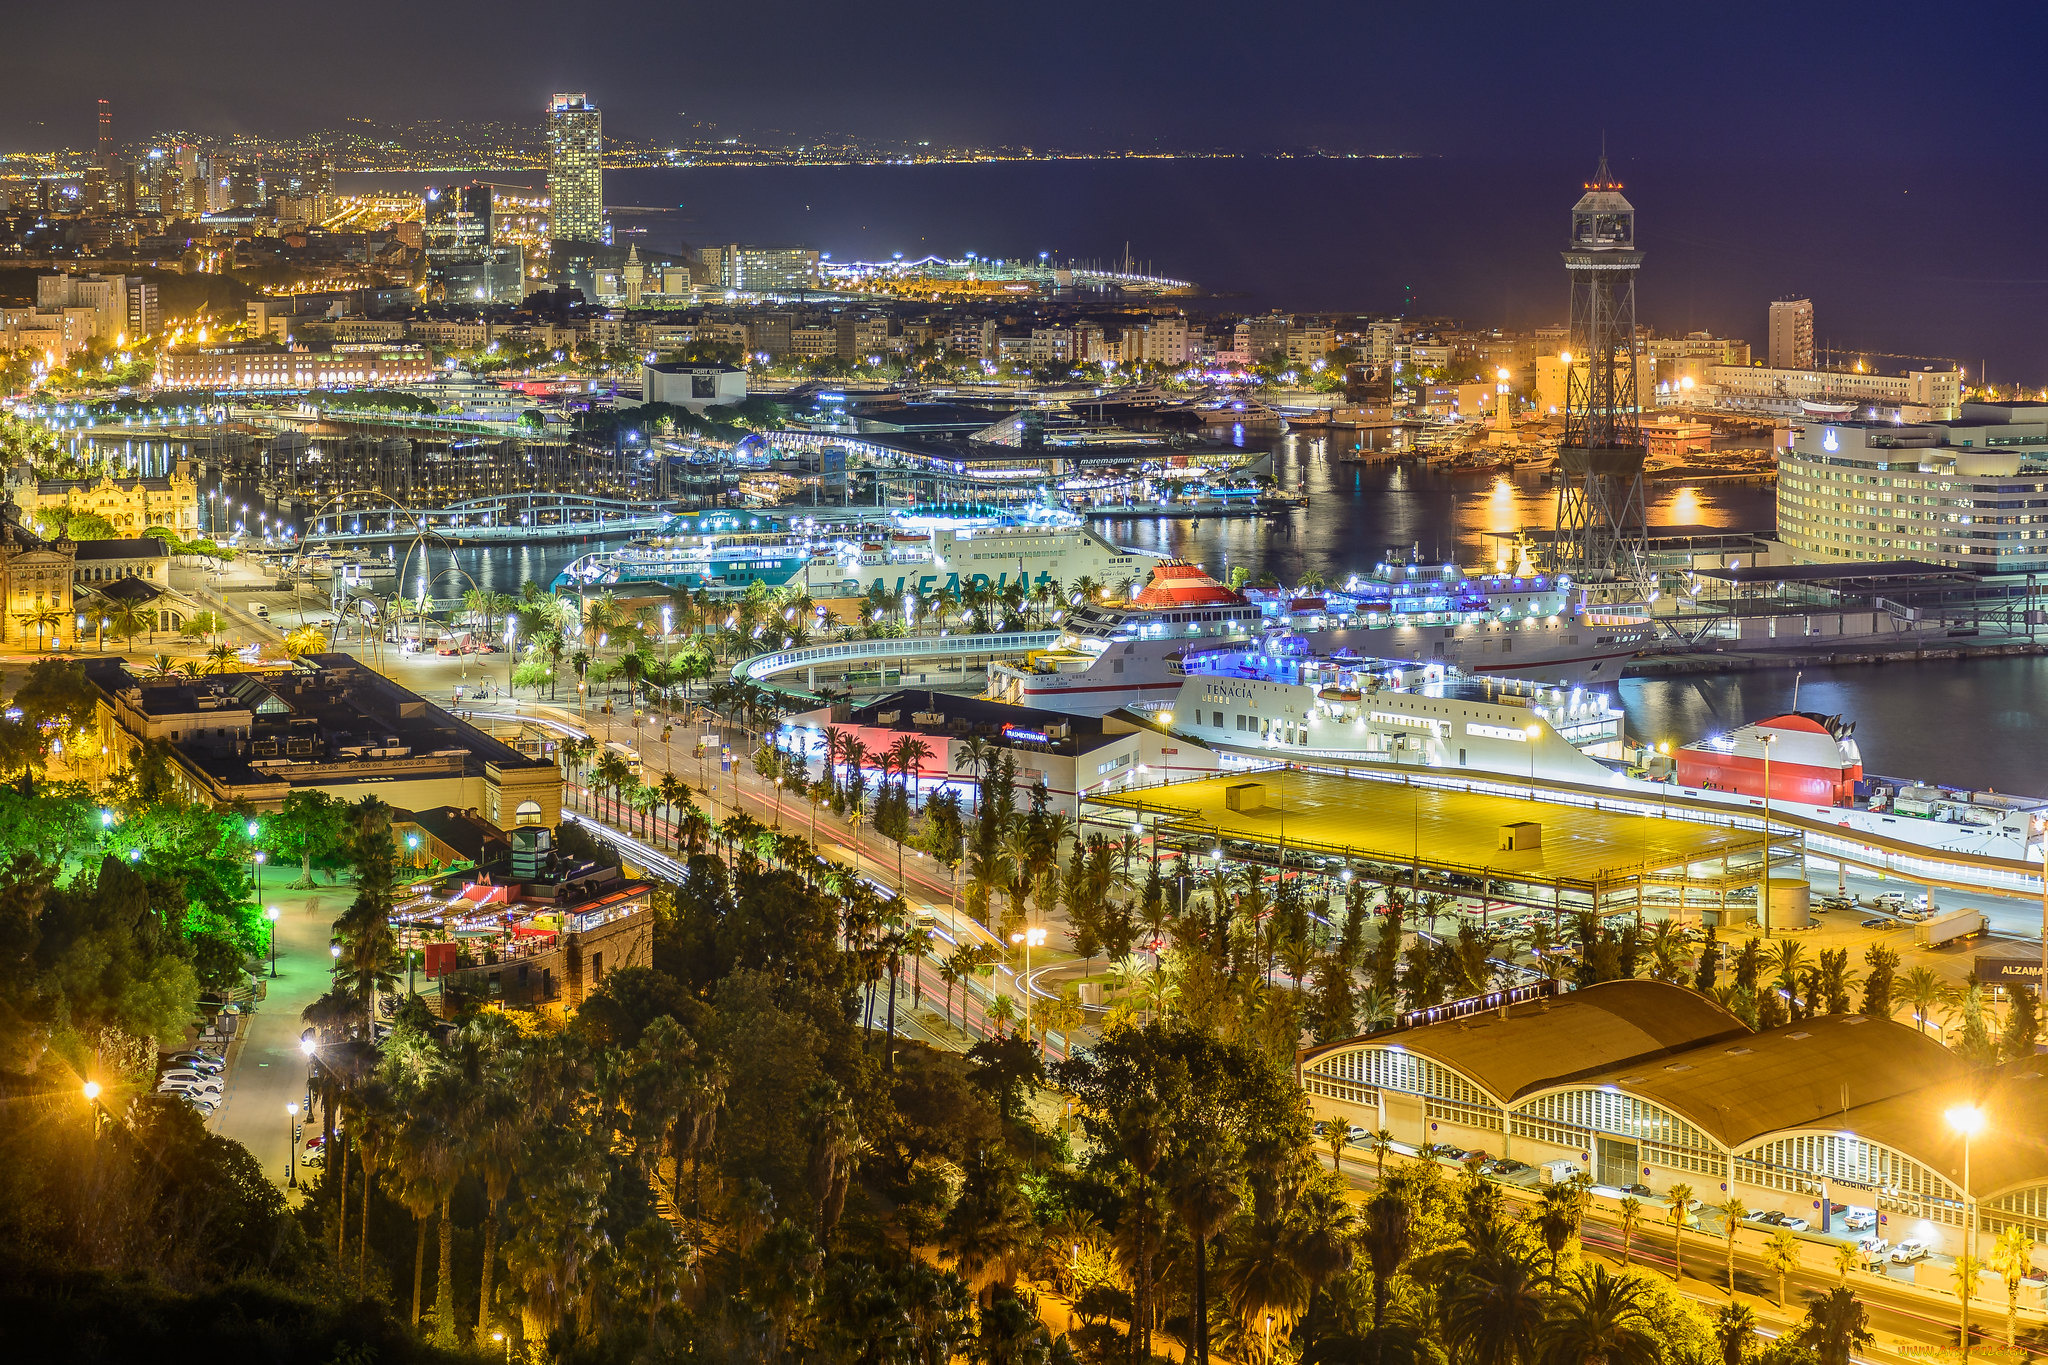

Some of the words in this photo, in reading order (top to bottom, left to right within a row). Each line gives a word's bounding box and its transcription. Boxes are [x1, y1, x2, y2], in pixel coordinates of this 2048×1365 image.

[1080, 457, 1136, 465] maremagnum
[1206, 684, 1252, 699] TENACIA
[2001, 965, 2048, 977] ALZAMA
[1832, 1177, 1873, 1192] MOORING
